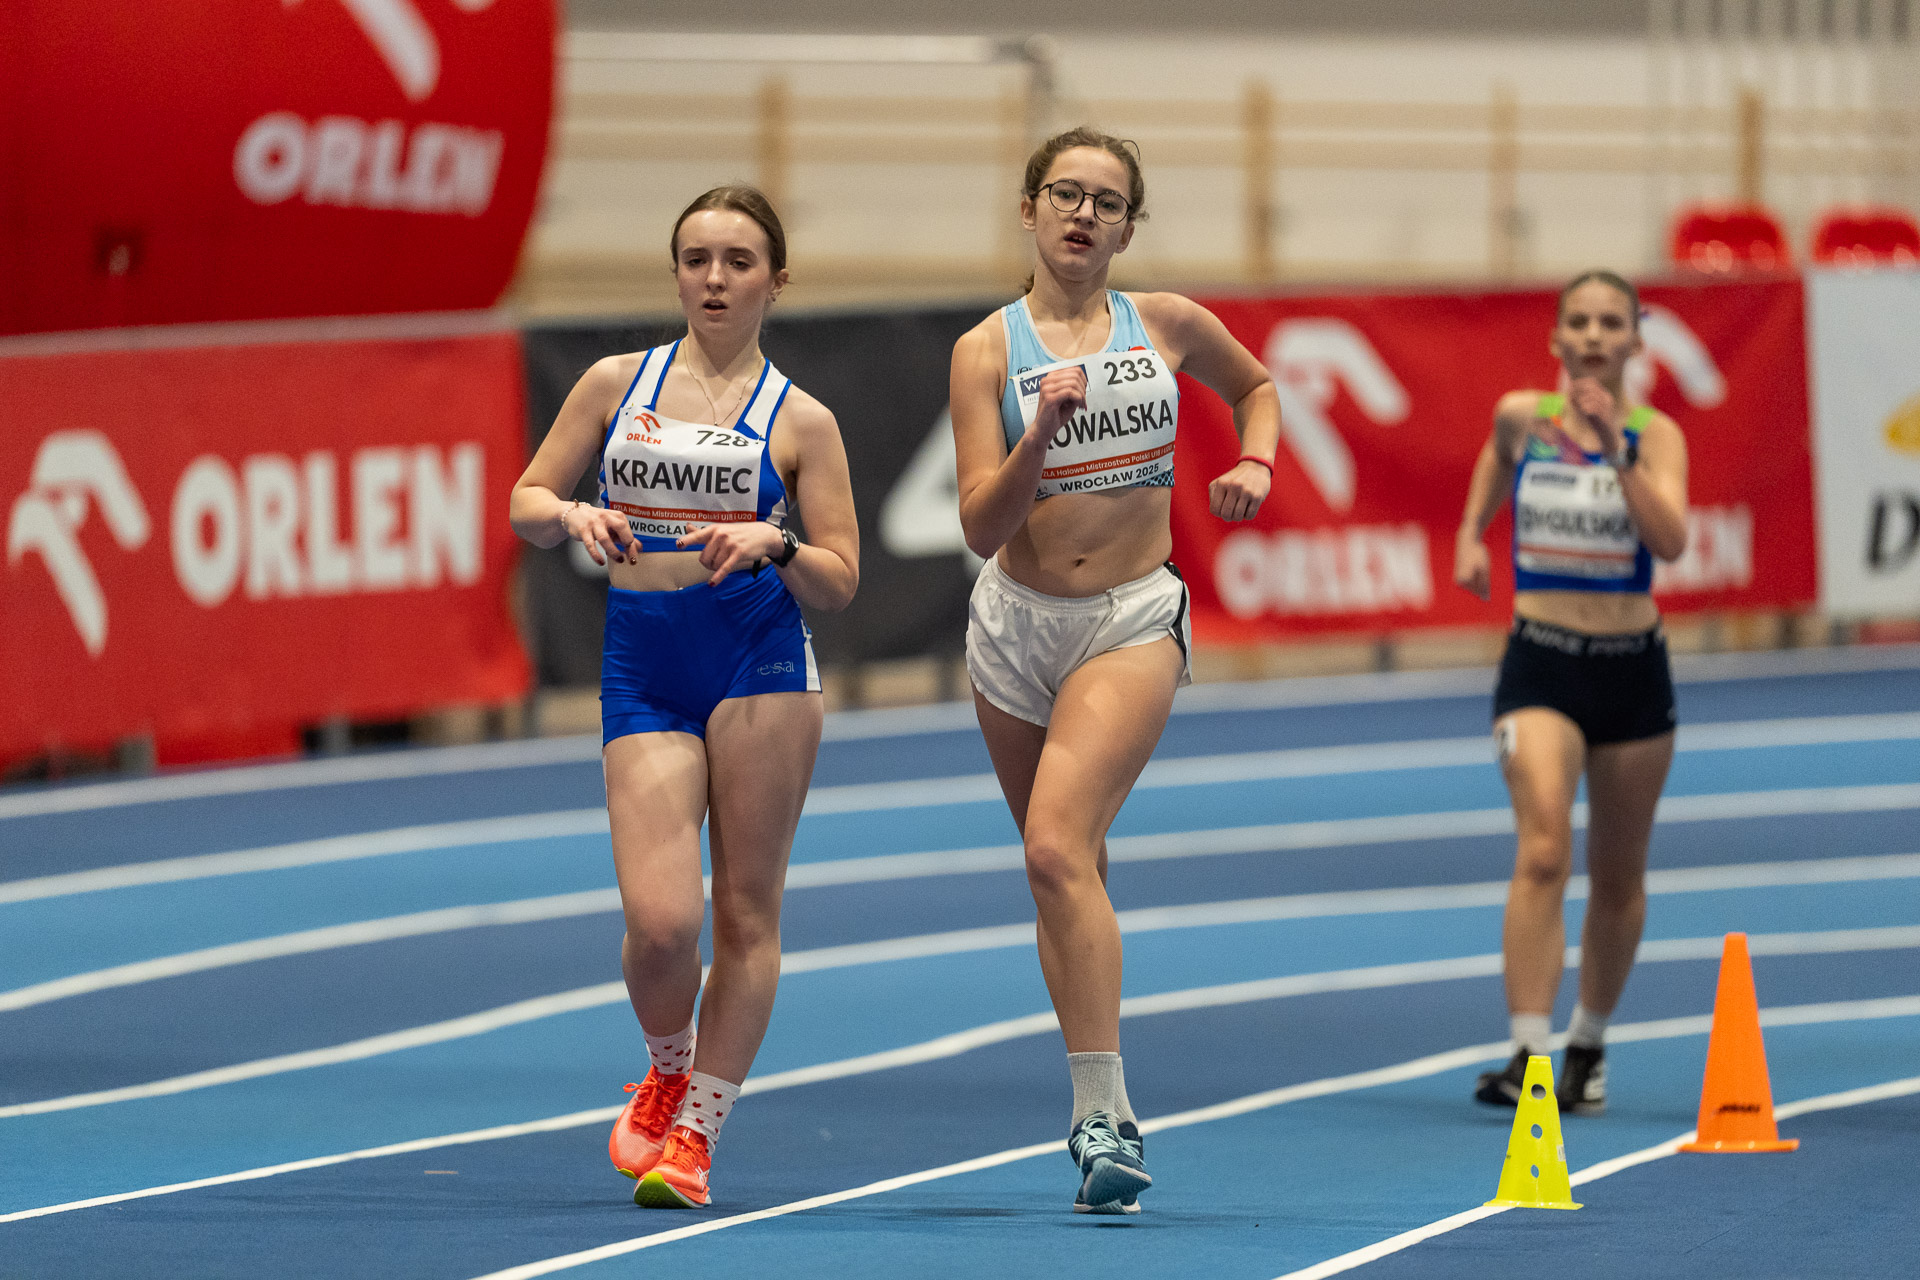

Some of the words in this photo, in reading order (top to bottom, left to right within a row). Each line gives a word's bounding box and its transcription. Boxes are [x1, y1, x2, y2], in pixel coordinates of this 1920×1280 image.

[234, 112, 503, 217] ORLEN
[1104, 358, 1157, 385] 233
[626, 432, 662, 445] ORLEN
[695, 430, 750, 447] 728
[1047, 399, 1174, 450] OWALSKA
[611, 458, 752, 494] KRAWIEC
[1056, 466, 1085, 476] Halowe
[1086, 457, 1131, 471] Mistrzostwa
[1131, 453, 1151, 463] Polski
[1060, 471, 1134, 492] WROCŁAW
[1135, 463, 1160, 478] 2025
[170, 442, 486, 608] ORLEN
[629, 507, 650, 516] Halowe
[652, 510, 696, 519] Mistrzostwa
[698, 512, 720, 520] Polski
[1212, 527, 1431, 619] ORLEN
